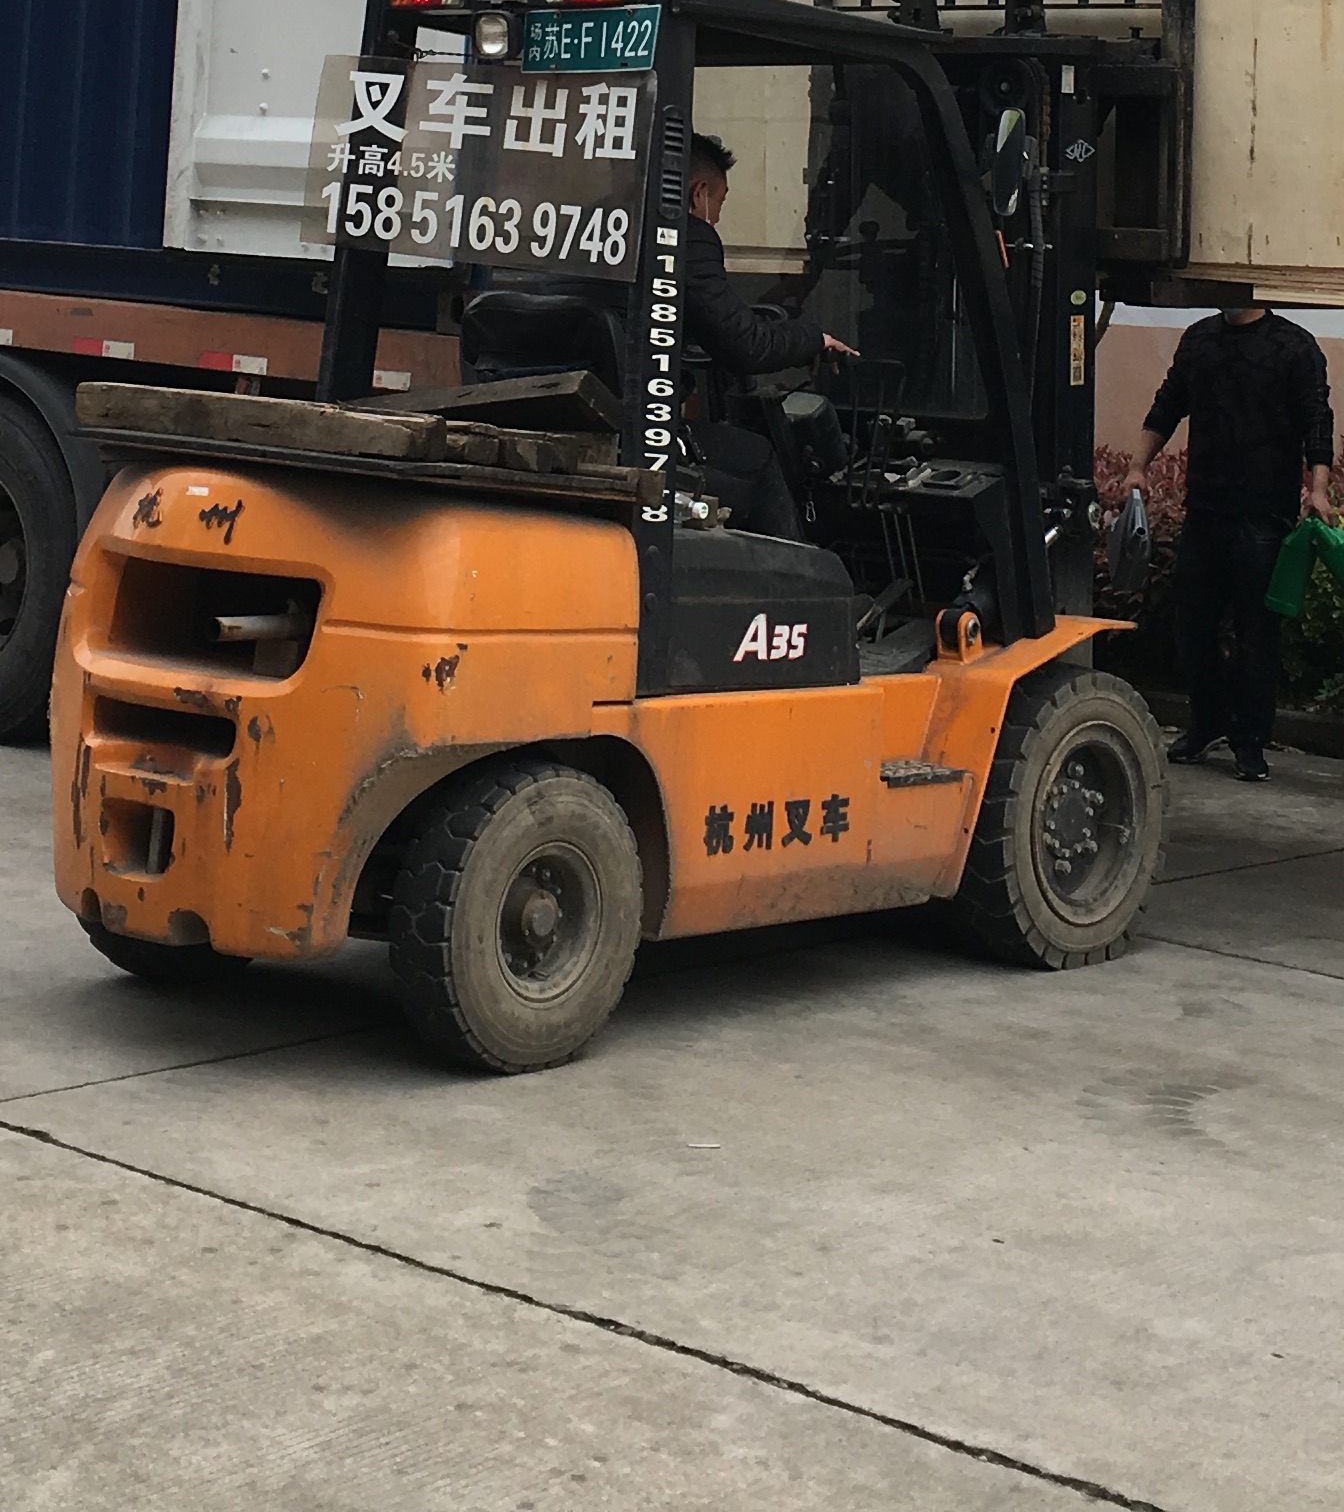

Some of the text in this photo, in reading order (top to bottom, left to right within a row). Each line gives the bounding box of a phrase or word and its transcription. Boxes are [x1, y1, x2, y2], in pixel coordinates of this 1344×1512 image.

[333, 70, 638, 161] 叉车出租
[326, 143, 457, 183] 升高4.5米
[641, 254, 678, 522] 1585163978
[733, 613, 808, 663] A35
[703, 793, 850, 856] 杭州叉车
